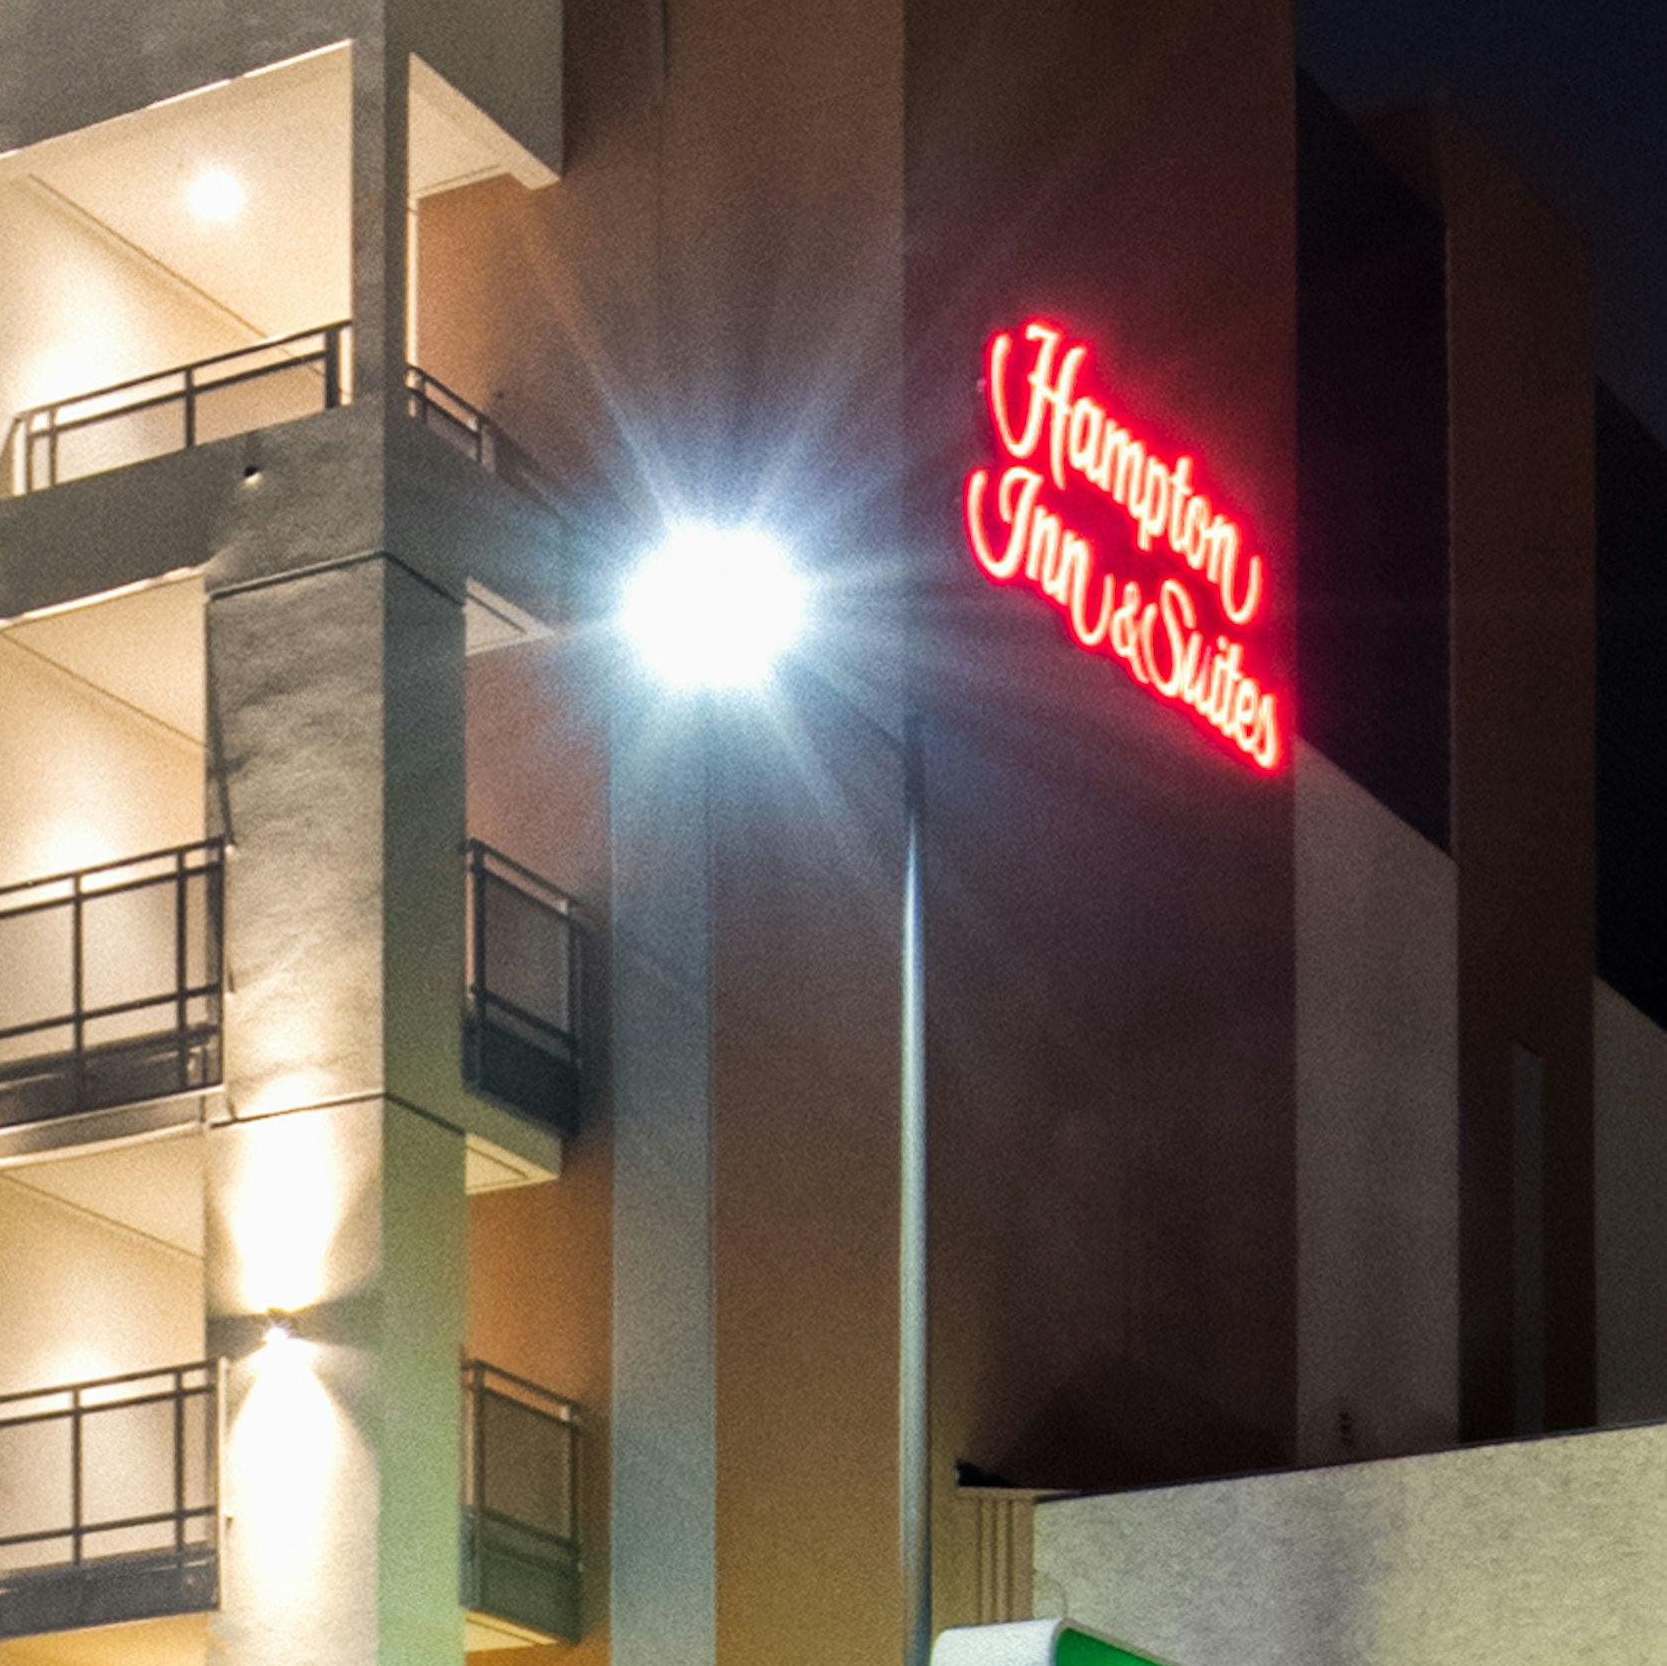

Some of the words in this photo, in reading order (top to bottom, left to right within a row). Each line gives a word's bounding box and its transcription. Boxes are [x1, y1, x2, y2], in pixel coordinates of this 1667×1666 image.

[966, 465, 1115, 646] Inn
[1110, 580, 1149, 683] &
[1143, 579, 1277, 769] Suites
[990, 323, 1263, 624] Hampton
